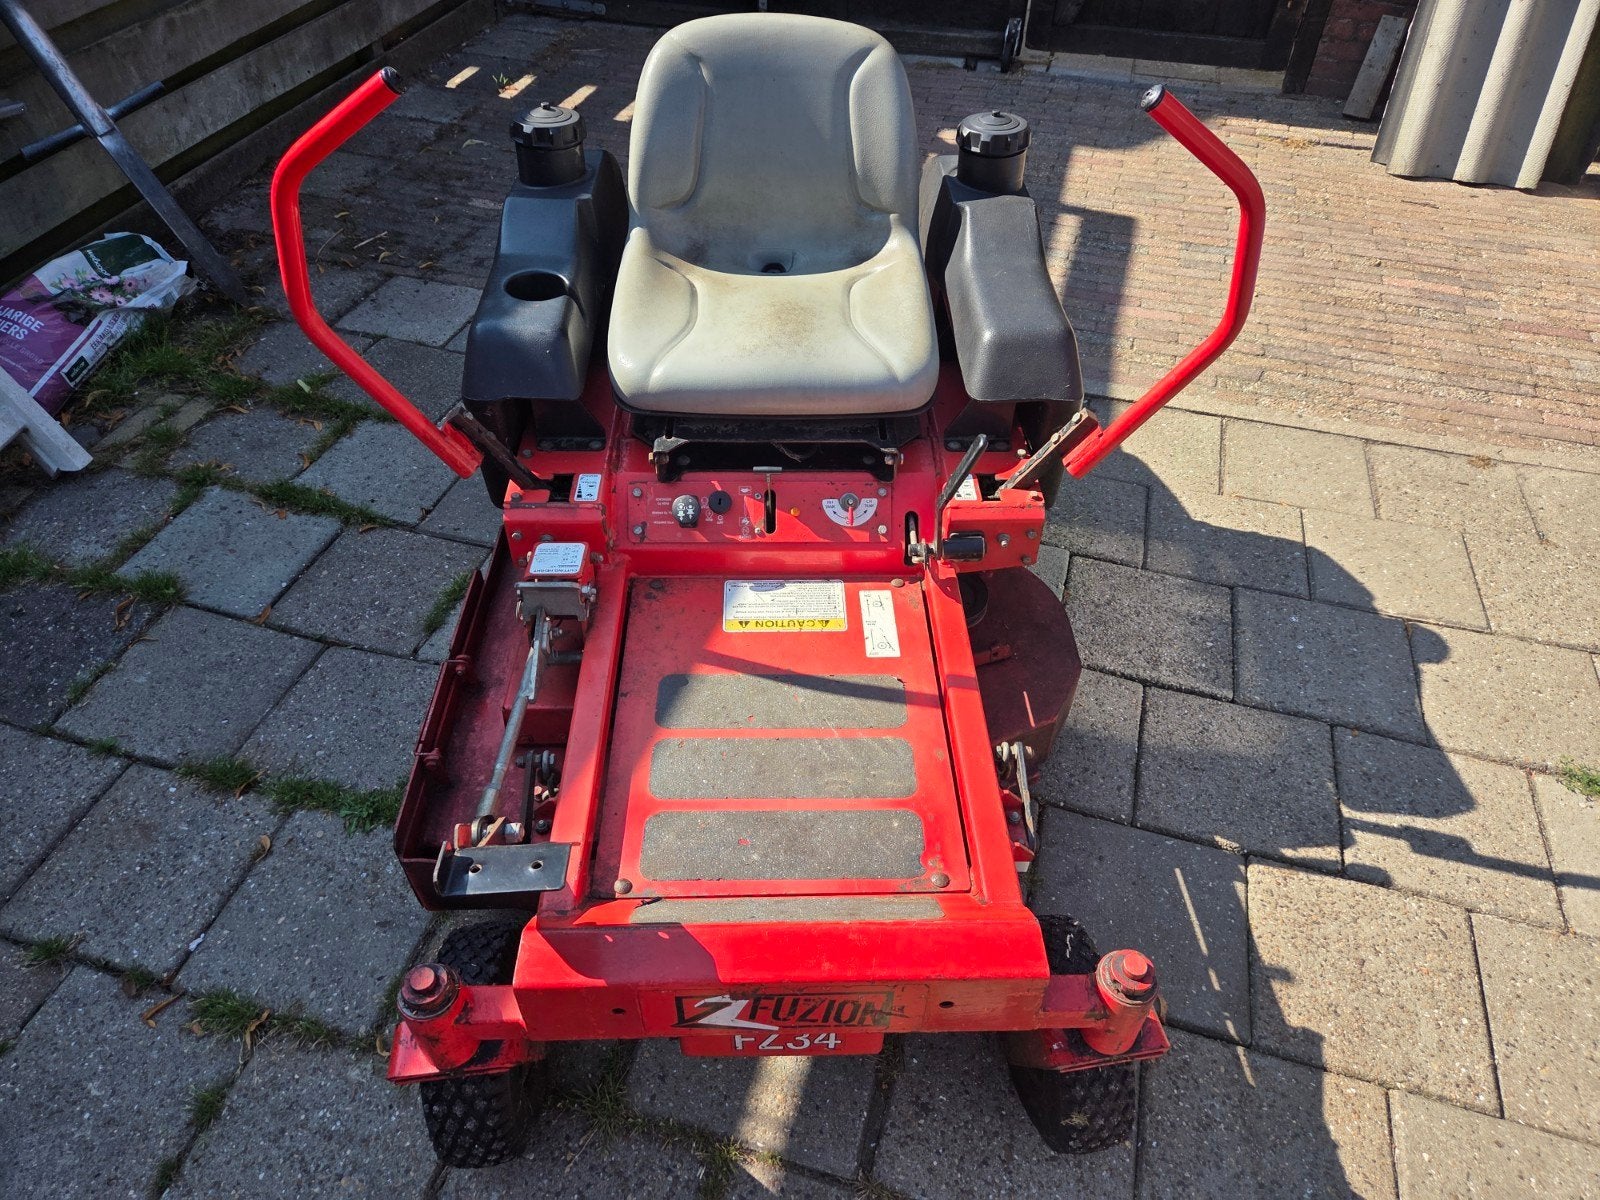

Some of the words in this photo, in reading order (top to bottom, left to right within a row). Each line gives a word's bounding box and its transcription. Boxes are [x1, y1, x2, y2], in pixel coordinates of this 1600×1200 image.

[755, 620, 816, 628] CAUTION
[748, 994, 884, 1025] FUZION
[733, 1032, 842, 1050] FZ34
